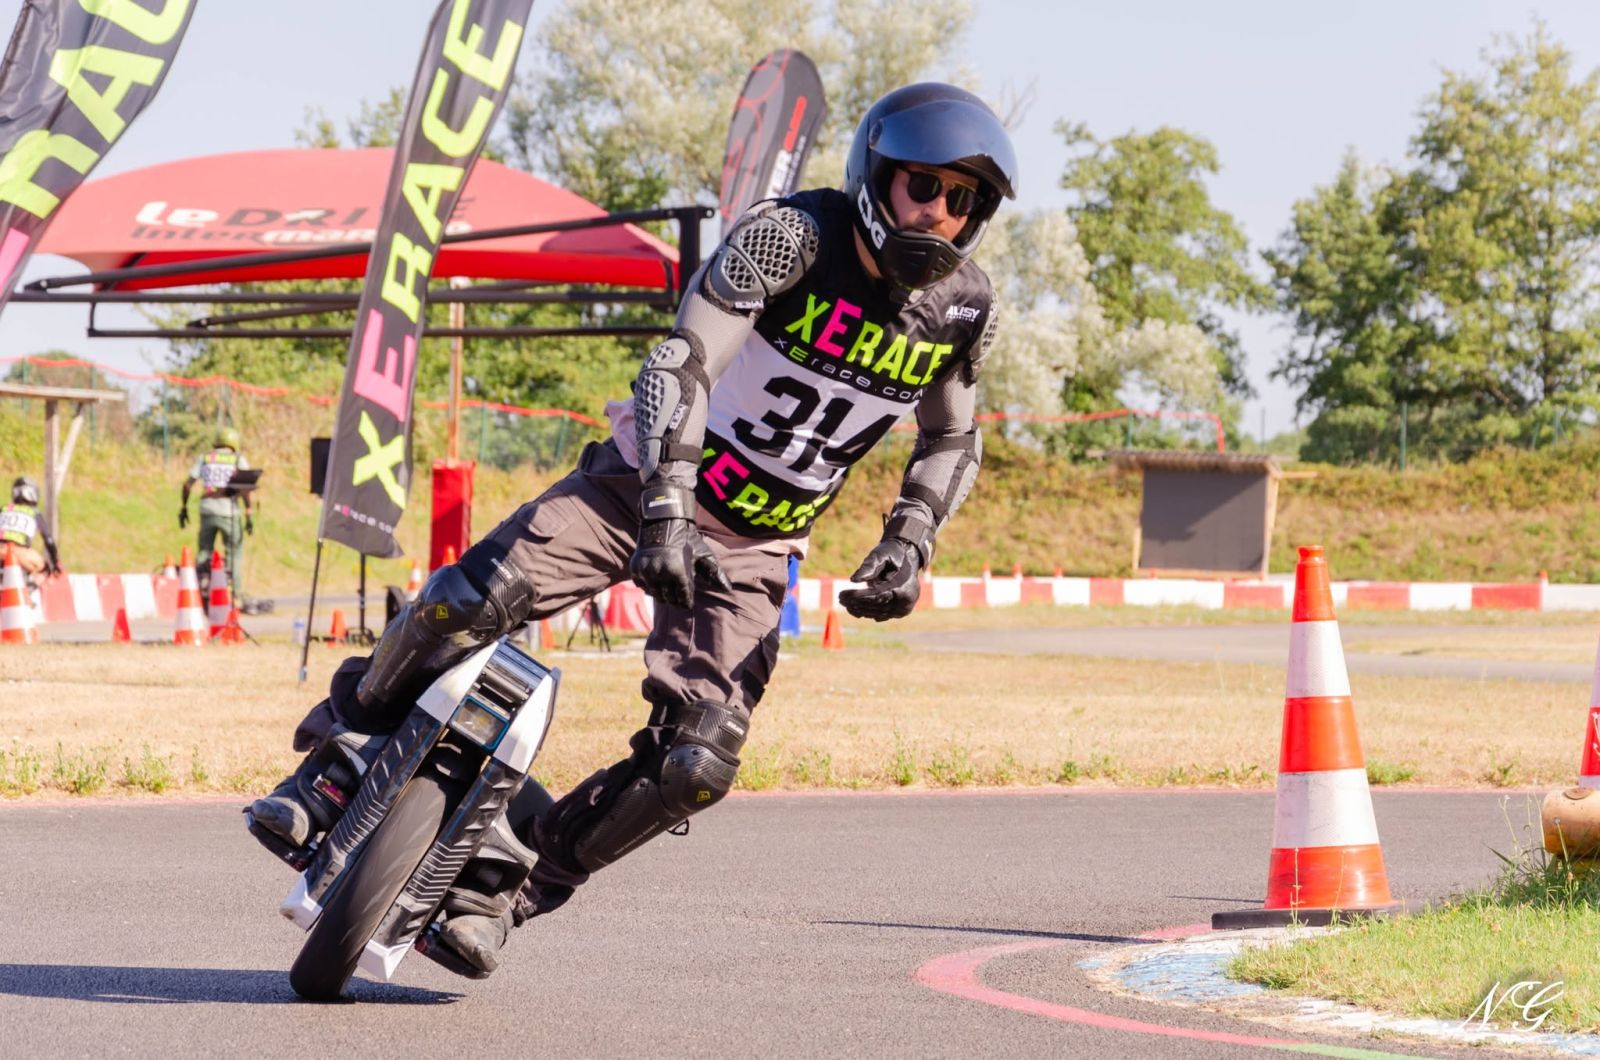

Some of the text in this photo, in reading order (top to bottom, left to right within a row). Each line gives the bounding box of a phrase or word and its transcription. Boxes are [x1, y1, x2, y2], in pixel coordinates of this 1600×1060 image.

[352, 0, 523, 510] XERACE
[784, 293, 953, 386] XERACE
[731, 376, 900, 474] 314
